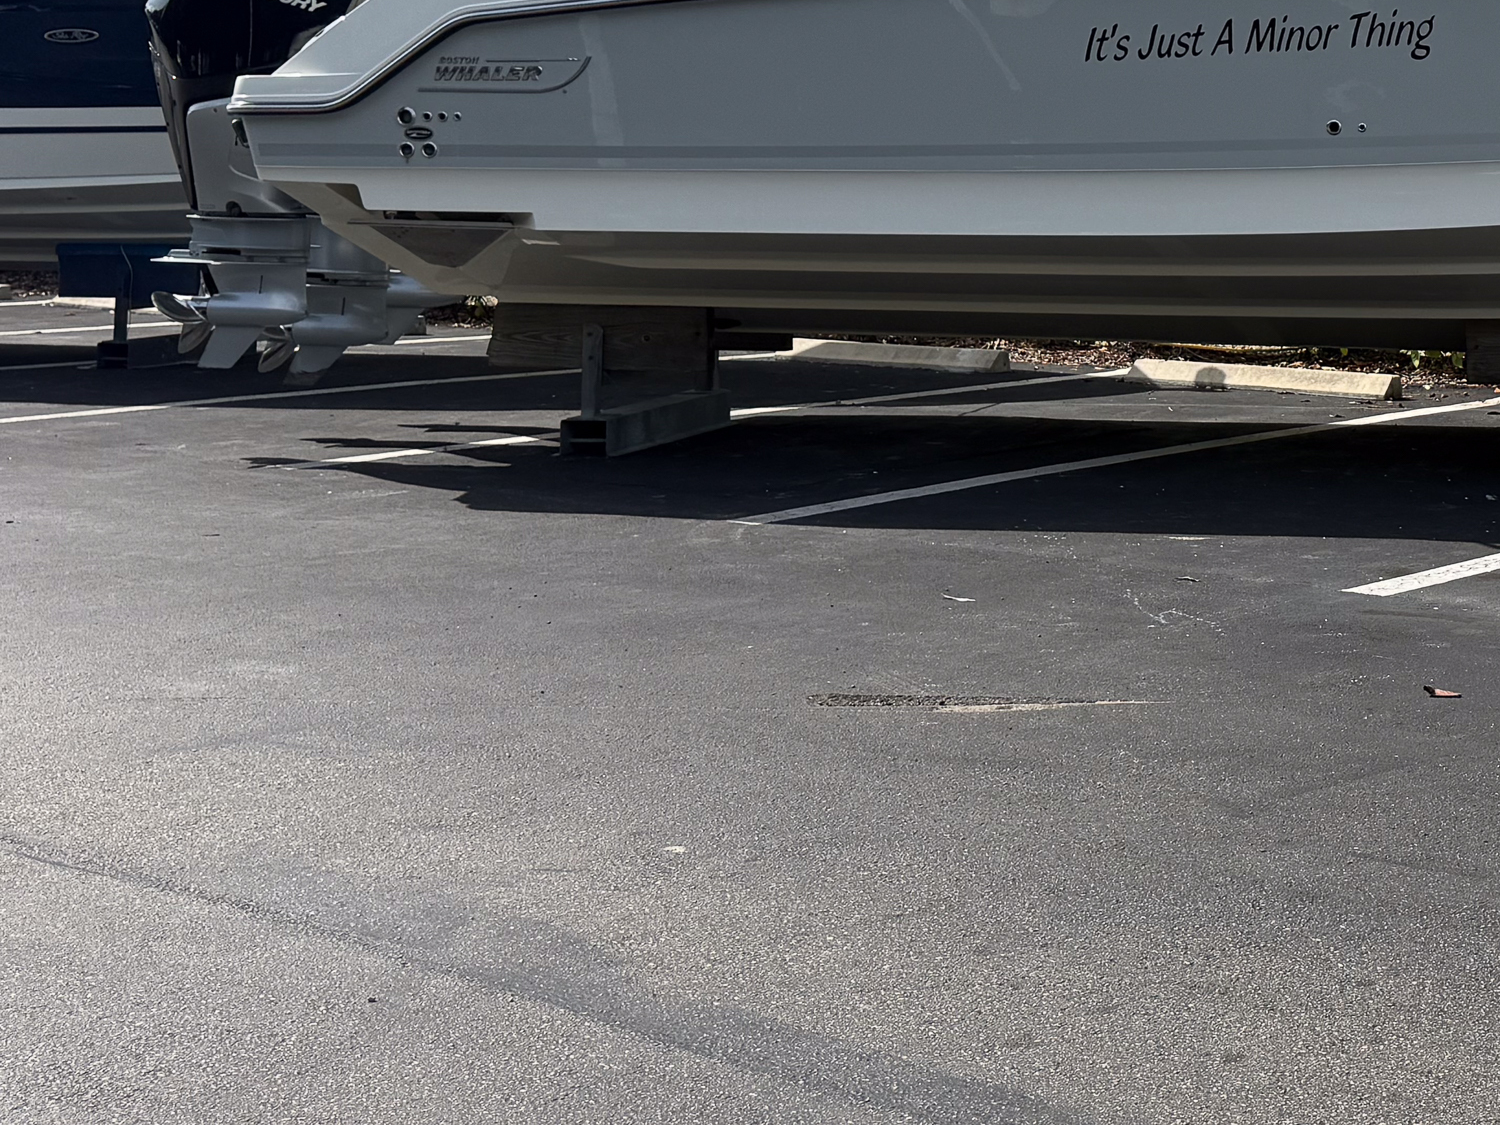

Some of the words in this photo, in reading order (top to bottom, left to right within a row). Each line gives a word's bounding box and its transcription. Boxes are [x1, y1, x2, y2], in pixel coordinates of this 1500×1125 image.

[1084, 23, 1130, 62] It's
[1137, 23, 1205, 61] Just
[1211, 17, 1234, 56] A
[1244, 14, 1339, 55] Minor
[1350, 8, 1436, 61] Thing
[438, 56, 480, 65] BOSTON
[434, 65, 543, 82] WHALER
